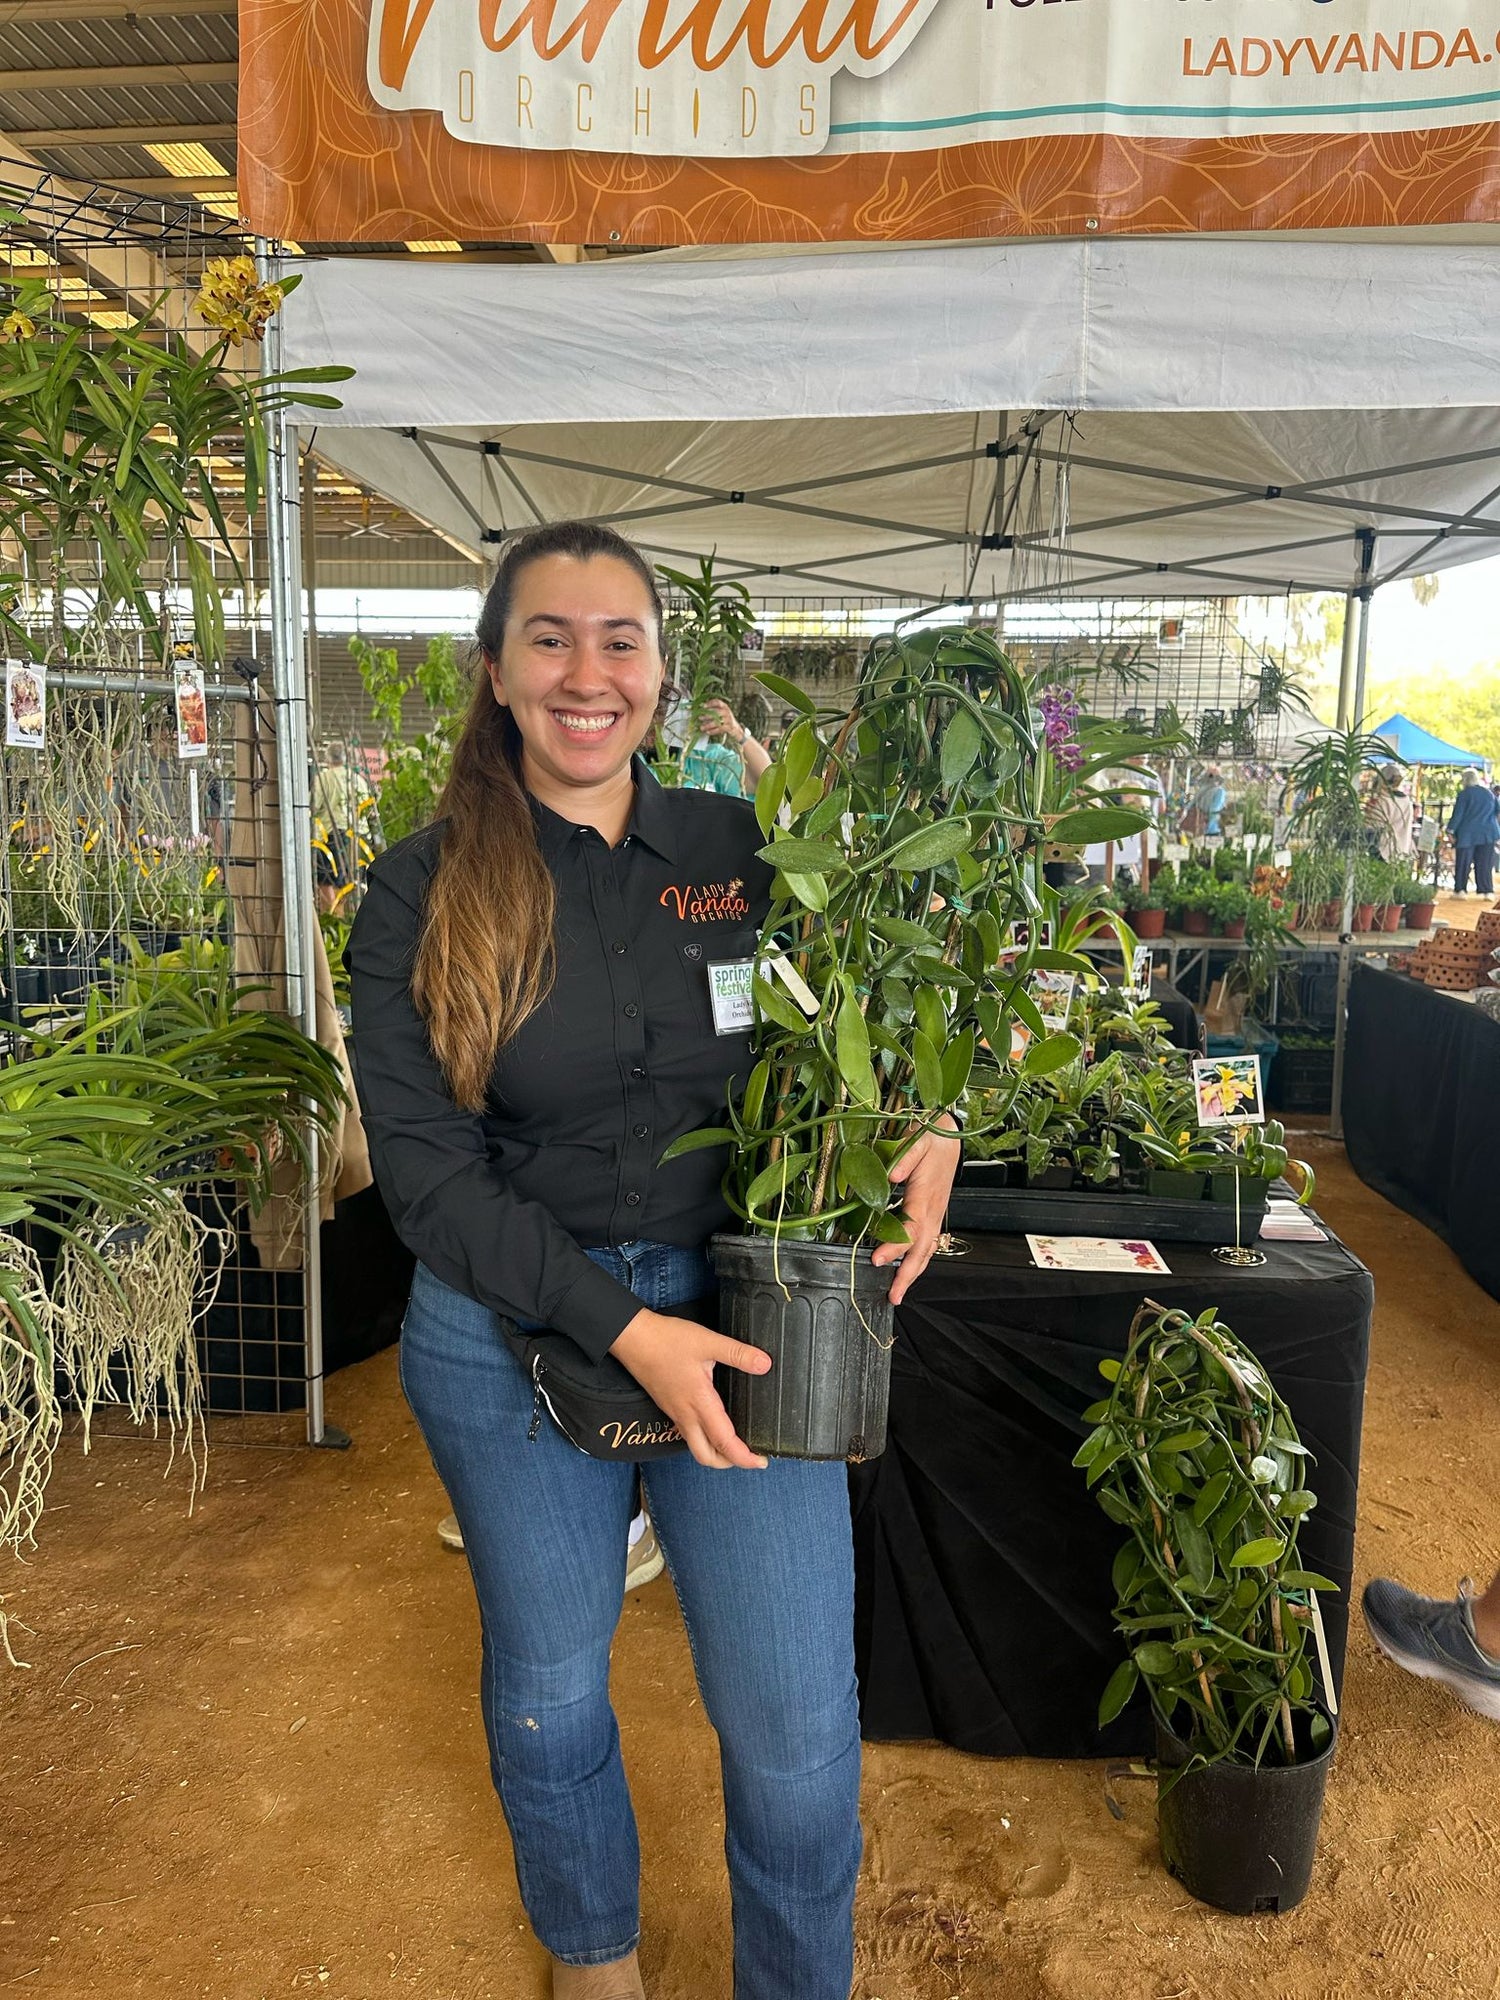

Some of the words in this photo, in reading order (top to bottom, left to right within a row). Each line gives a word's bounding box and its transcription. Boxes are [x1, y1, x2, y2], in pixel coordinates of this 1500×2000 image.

[1183, 28, 1500, 77] LADYVANDA.
[458, 70, 815, 138] ORCHIDS
[694, 883, 725, 900] LADY
[659, 886, 749, 920] Vanda
[691, 911, 742, 923] ORCHIDS
[715, 966, 751, 984] spring
[716, 981, 752, 997] festiva
[638, 1421, 670, 1434] LADY
